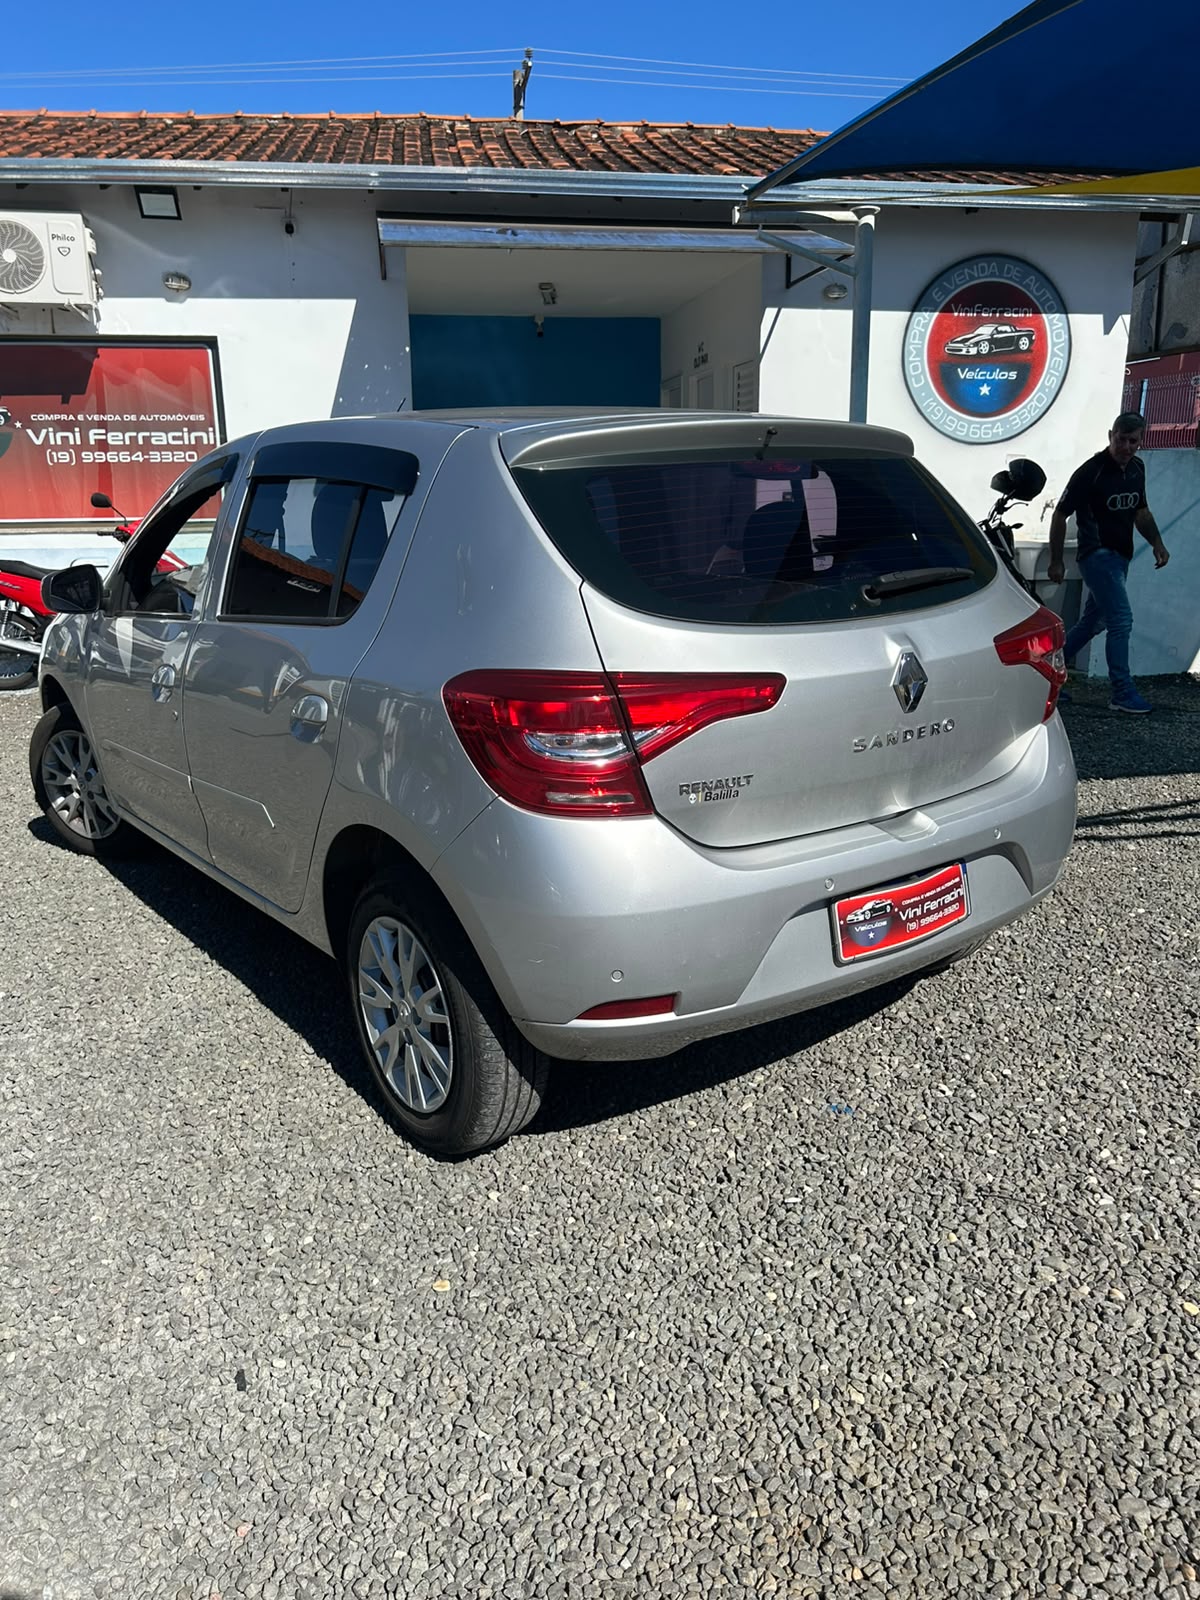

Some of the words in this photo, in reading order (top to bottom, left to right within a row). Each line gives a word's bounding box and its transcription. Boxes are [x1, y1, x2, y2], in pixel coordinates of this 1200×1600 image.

[51, 233, 76, 242] Philco
[909, 306, 934, 388] COMPRA
[932, 287, 945, 302] E
[944, 262, 999, 290] VENDA
[1003, 263, 1025, 281] DE
[957, 367, 1018, 380] Veículos
[139, 413, 206, 421] AUTOMÓVEIS
[26, 427, 81, 445] Vini
[89, 427, 215, 445] Ferracini
[46, 449, 76, 466] (19)
[81, 451, 198, 463] 99664-3320
[852, 718, 955, 754] SANDERO
[679, 773, 754, 796] RENAULT
[704, 789, 740, 802] Balilla
[899, 904, 921, 921] Vini
[923, 884, 964, 913] Ferracini
[854, 920, 888, 932] Veículos
[906, 920, 919, 933] (19)
[920, 902, 960, 927] 99664-3320
